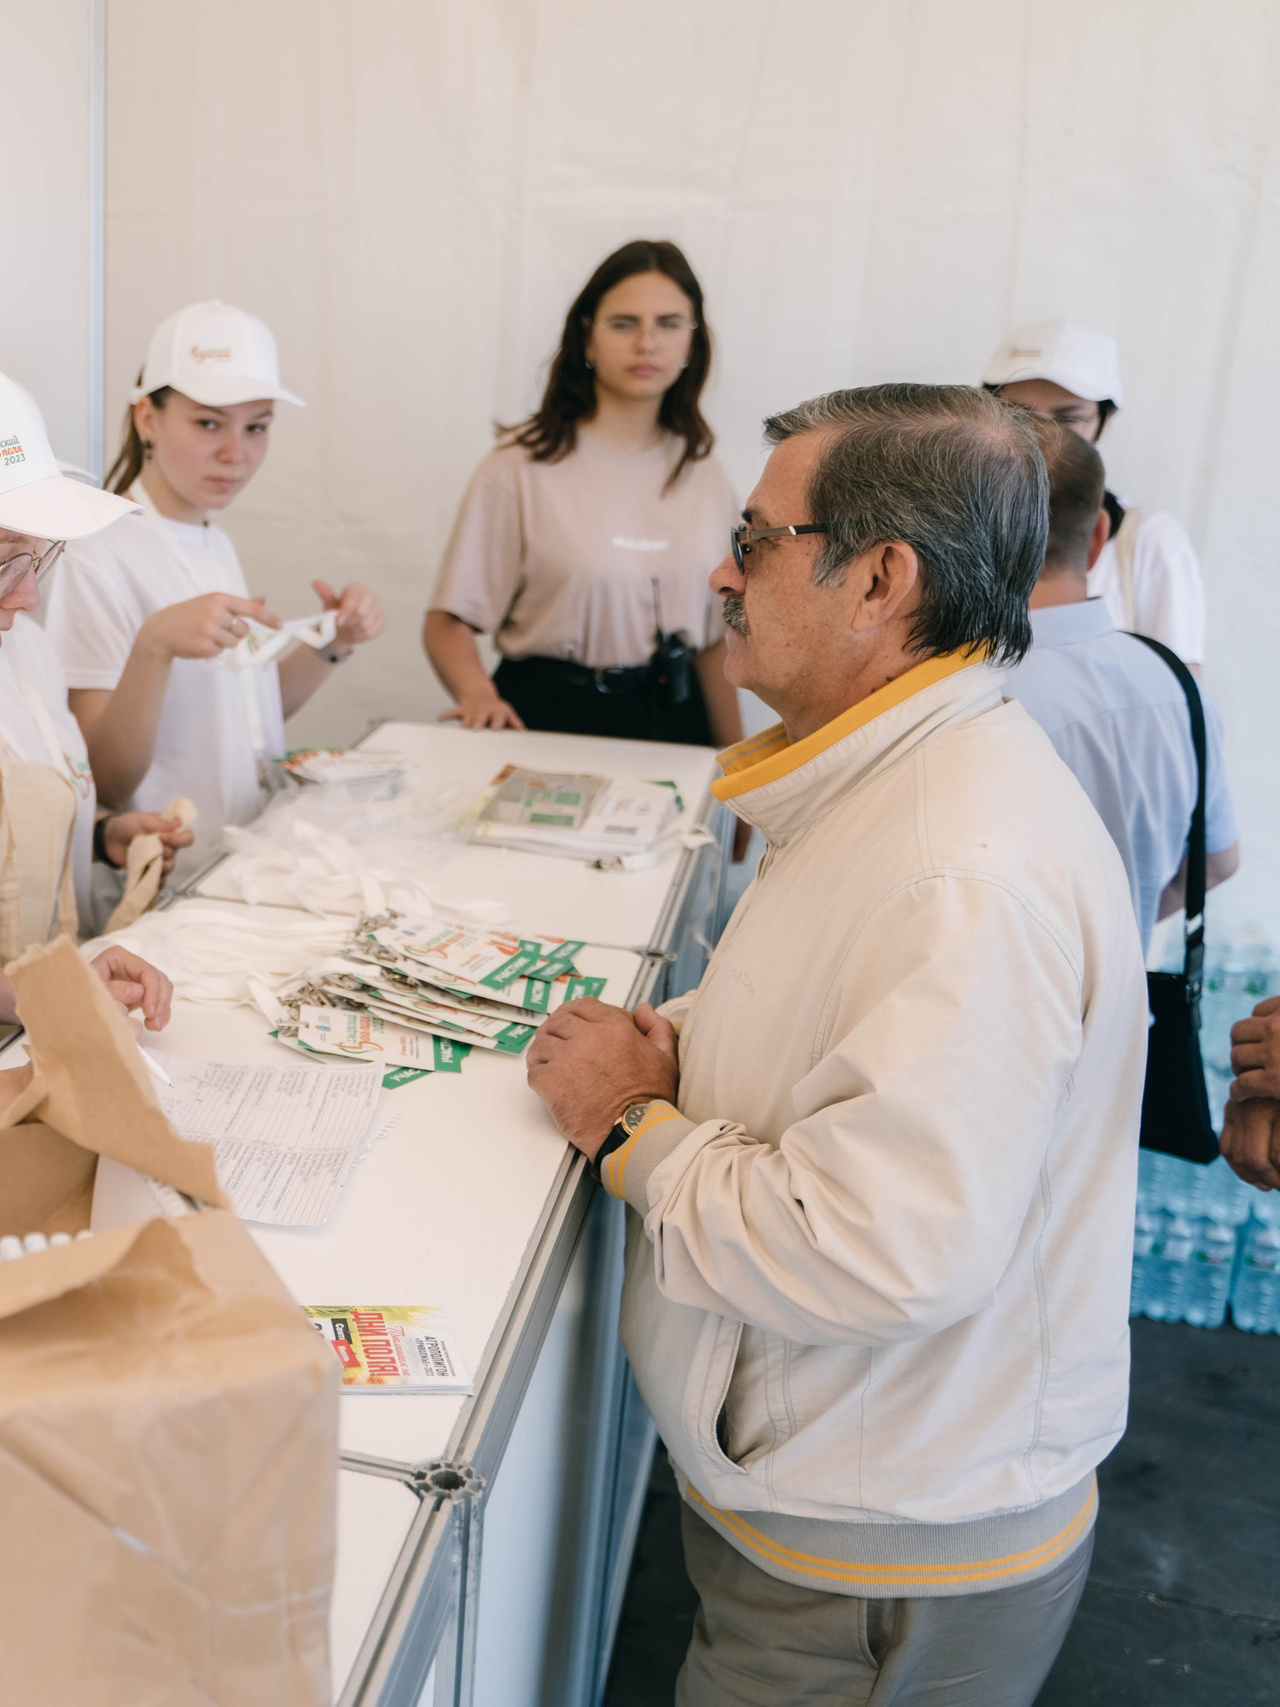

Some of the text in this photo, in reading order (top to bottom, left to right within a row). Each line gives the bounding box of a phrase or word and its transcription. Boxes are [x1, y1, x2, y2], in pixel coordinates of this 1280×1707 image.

[2, 445, 23, 457] поля
[4, 453, 26, 466] 2023
[350, 1311, 400, 1377] ДНИ ПОЛЯ!
[424, 1336, 449, 1377] АГРОПОЛИГОН
